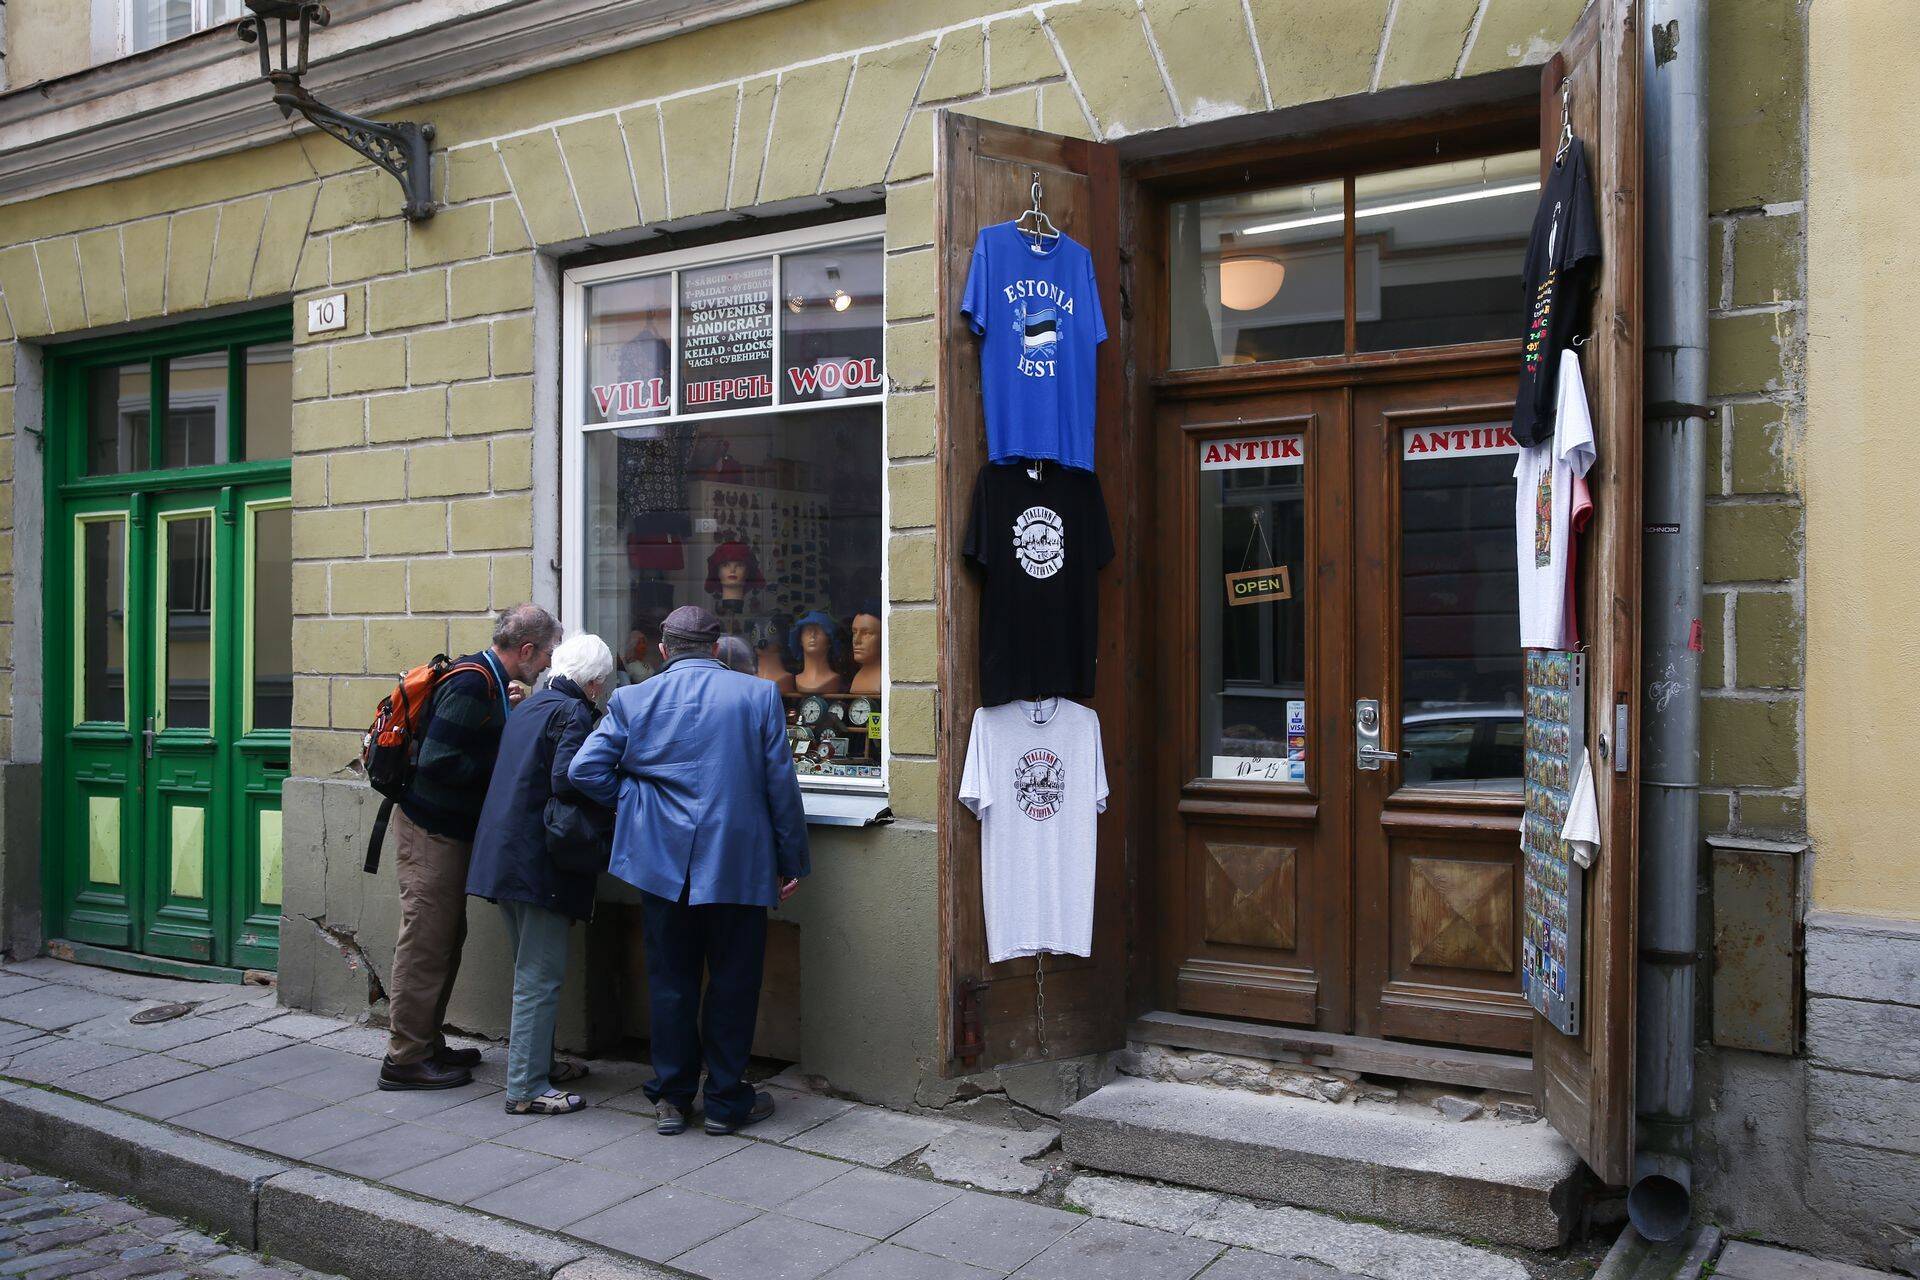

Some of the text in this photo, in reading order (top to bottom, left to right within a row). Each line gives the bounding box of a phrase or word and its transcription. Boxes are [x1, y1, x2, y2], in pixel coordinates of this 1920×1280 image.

[690, 290, 768, 312] SUVENIIRID
[1003, 279, 1075, 315] ESTONIA
[316, 302, 334, 325] 10
[692, 303, 766, 323] SOUVENIRS
[686, 314, 772, 337] HANDICRAFT
[685, 328, 773, 348] ANTIIK ANTIQUE
[684, 340, 773, 360] KELLAD CLOCKS
[688, 350, 770, 368] ЧАСЫ СУВЕНИРЫ
[788, 357, 882, 396] WOOL
[592, 377, 671, 418] VILL
[687, 374, 773, 405] ШЕРСТЬ
[1203, 438, 1301, 463] ANTIIK
[1407, 426, 1518, 453] ANTIIK
[1235, 578, 1280, 594] OPEN
